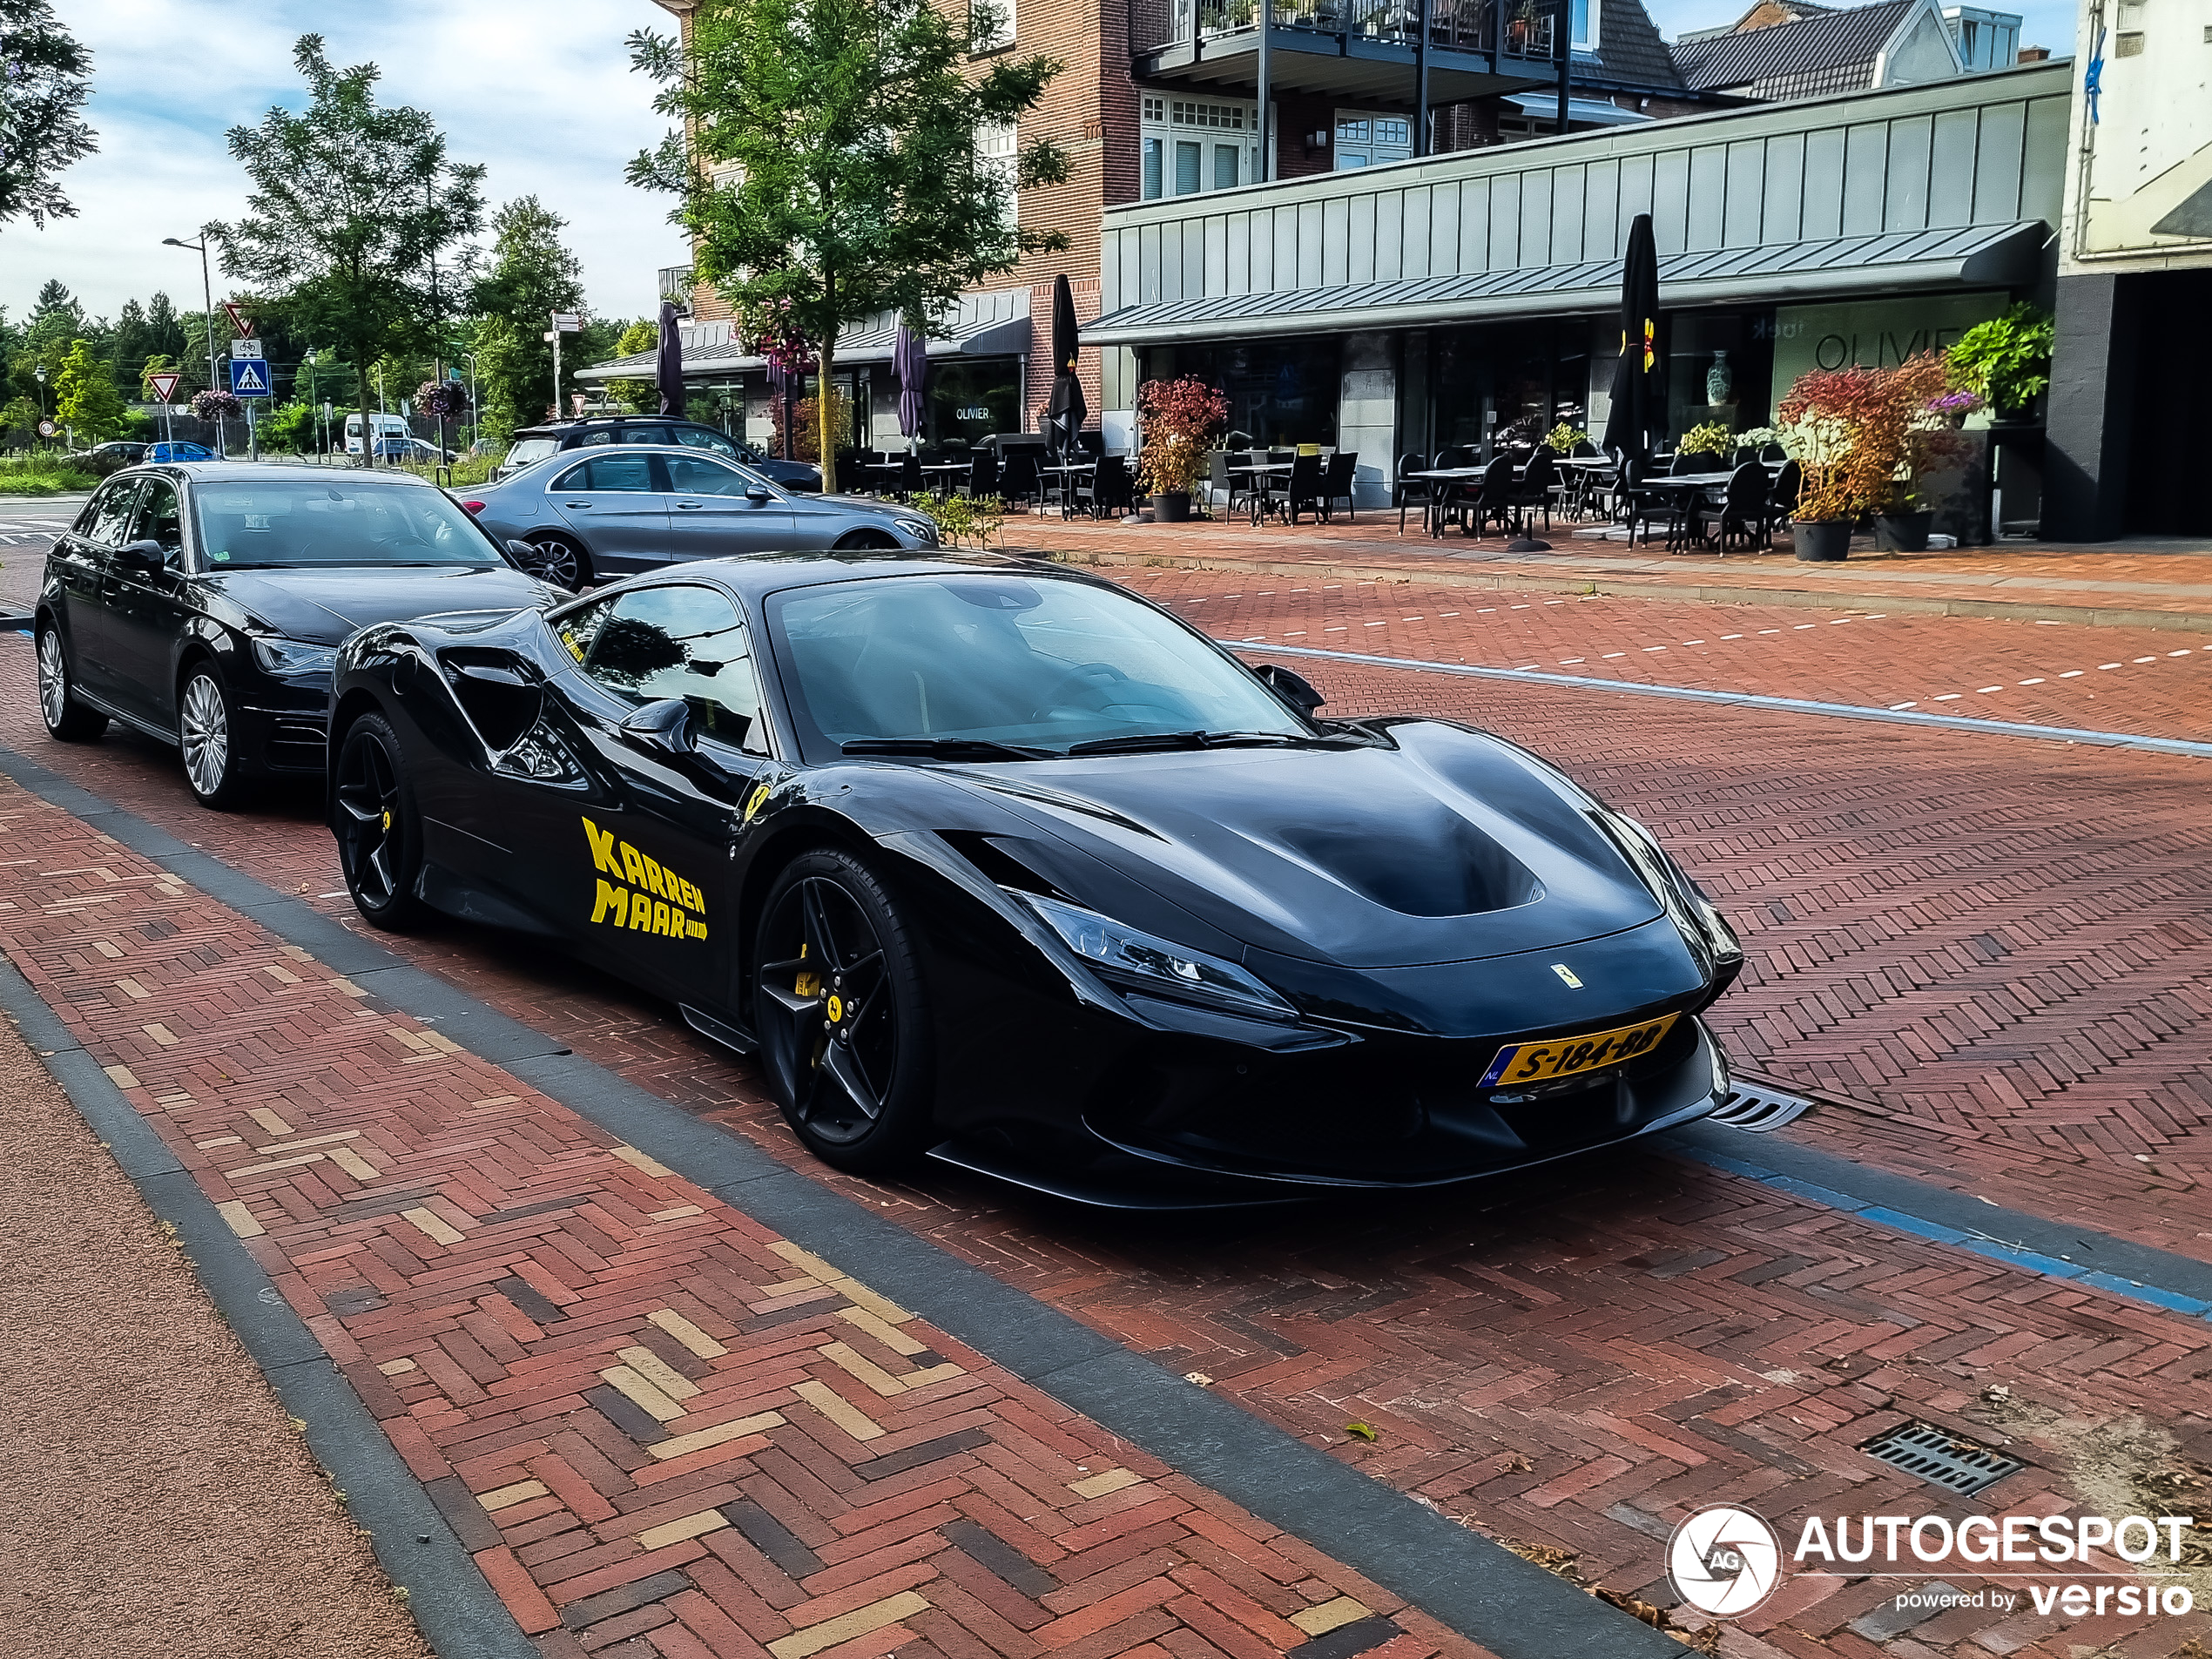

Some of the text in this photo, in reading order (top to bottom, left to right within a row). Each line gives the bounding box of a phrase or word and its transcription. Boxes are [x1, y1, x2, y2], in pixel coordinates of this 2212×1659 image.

[956, 408, 989, 420] OLIVIER
[582, 816, 705, 914] KARREN
[1516, 1023, 1662, 1077] S-184-BB
[1484, 1071, 1498, 1081] NL
